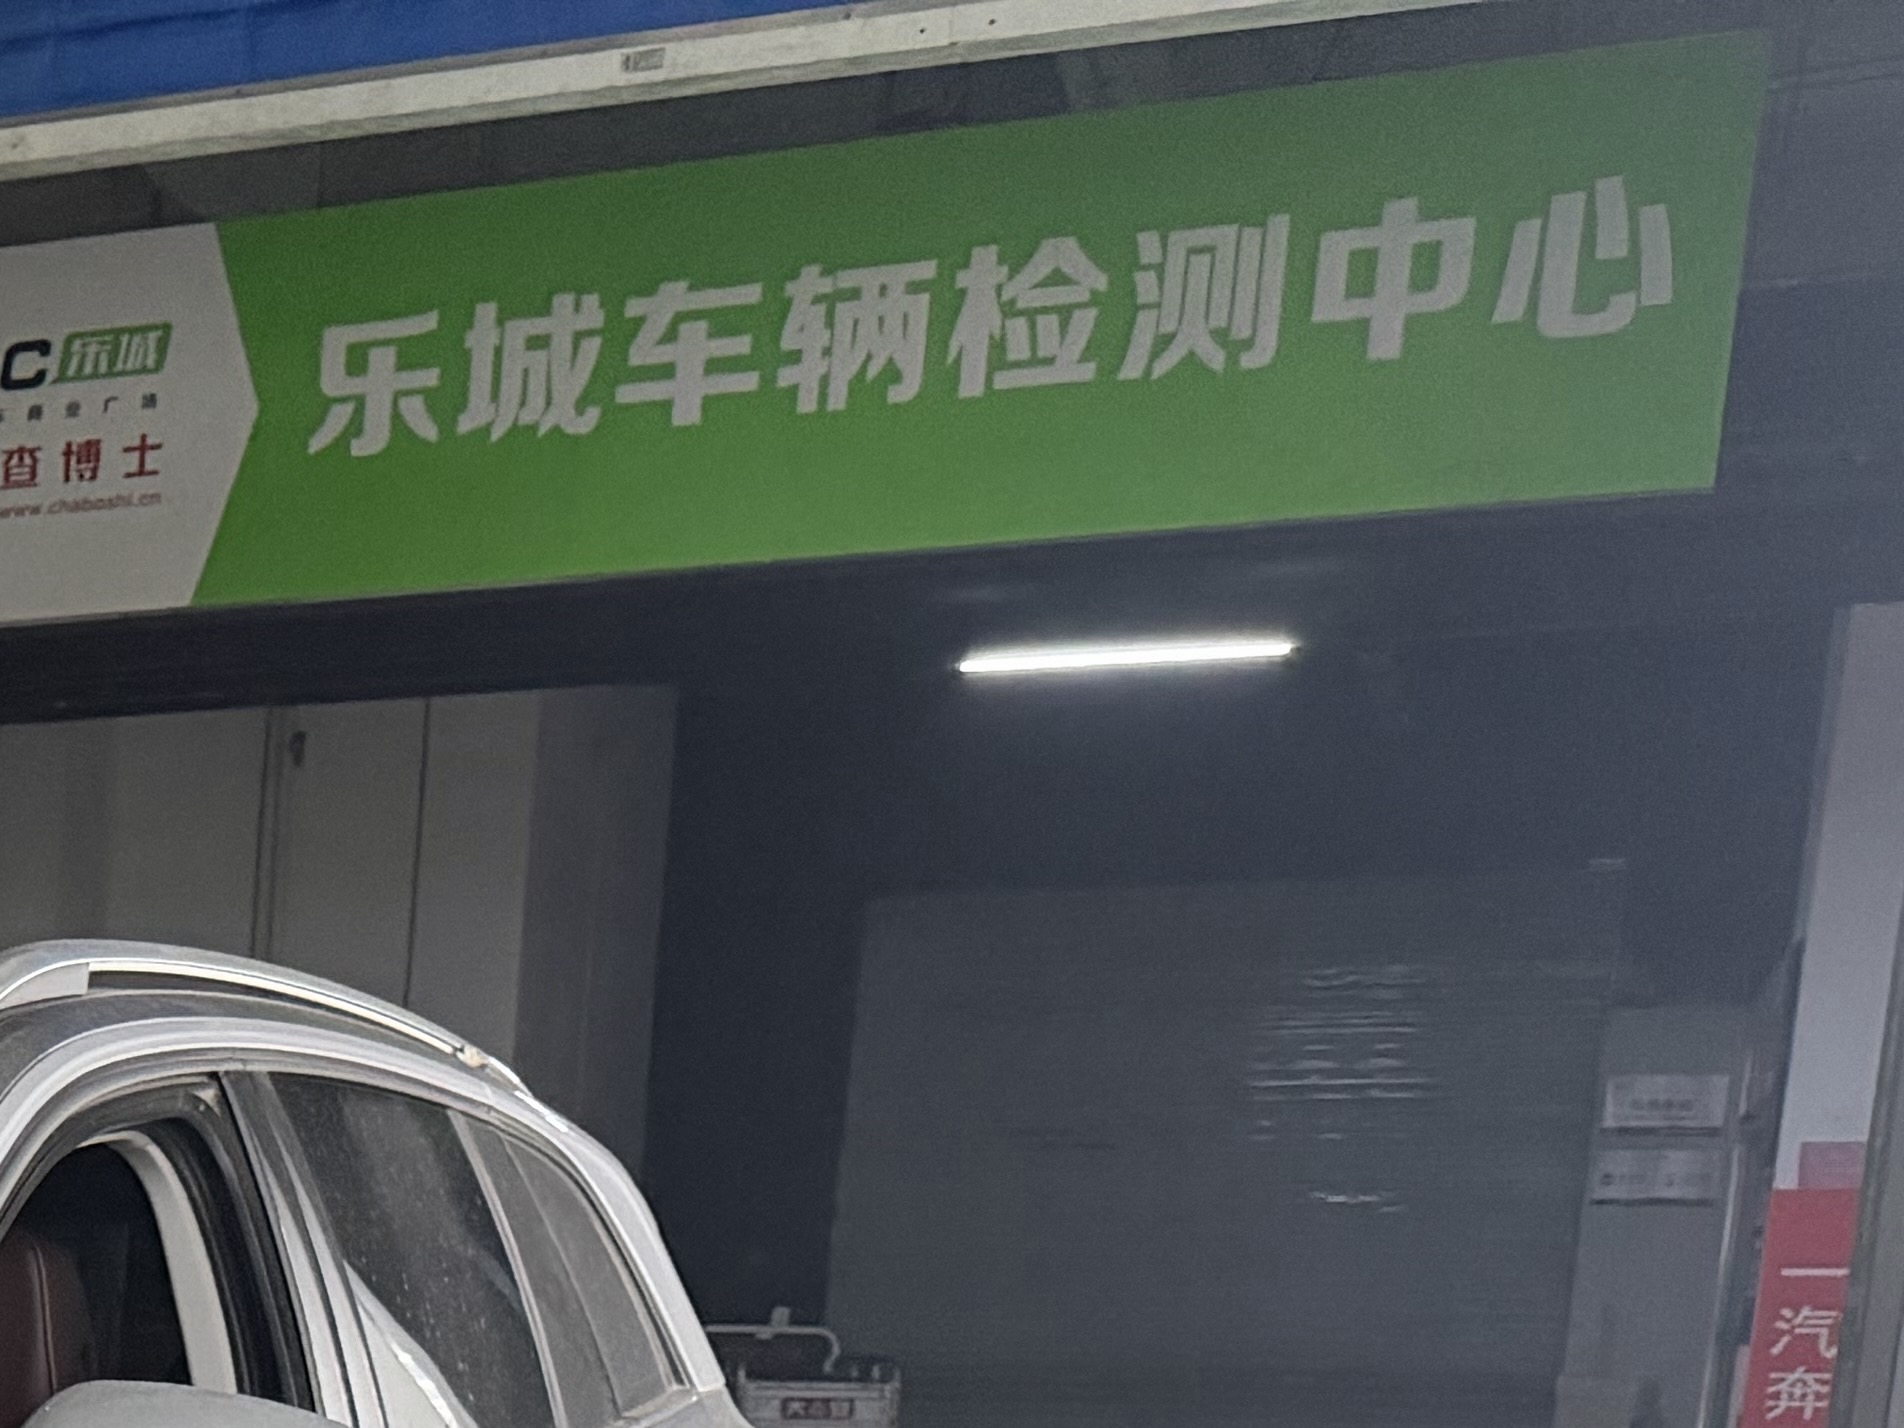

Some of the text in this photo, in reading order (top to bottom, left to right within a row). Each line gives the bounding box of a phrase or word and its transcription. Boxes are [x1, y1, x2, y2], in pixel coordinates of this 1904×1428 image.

[308, 175, 1674, 458] 乐城车辆检测中心
[0, 433, 163, 490] 查博士
